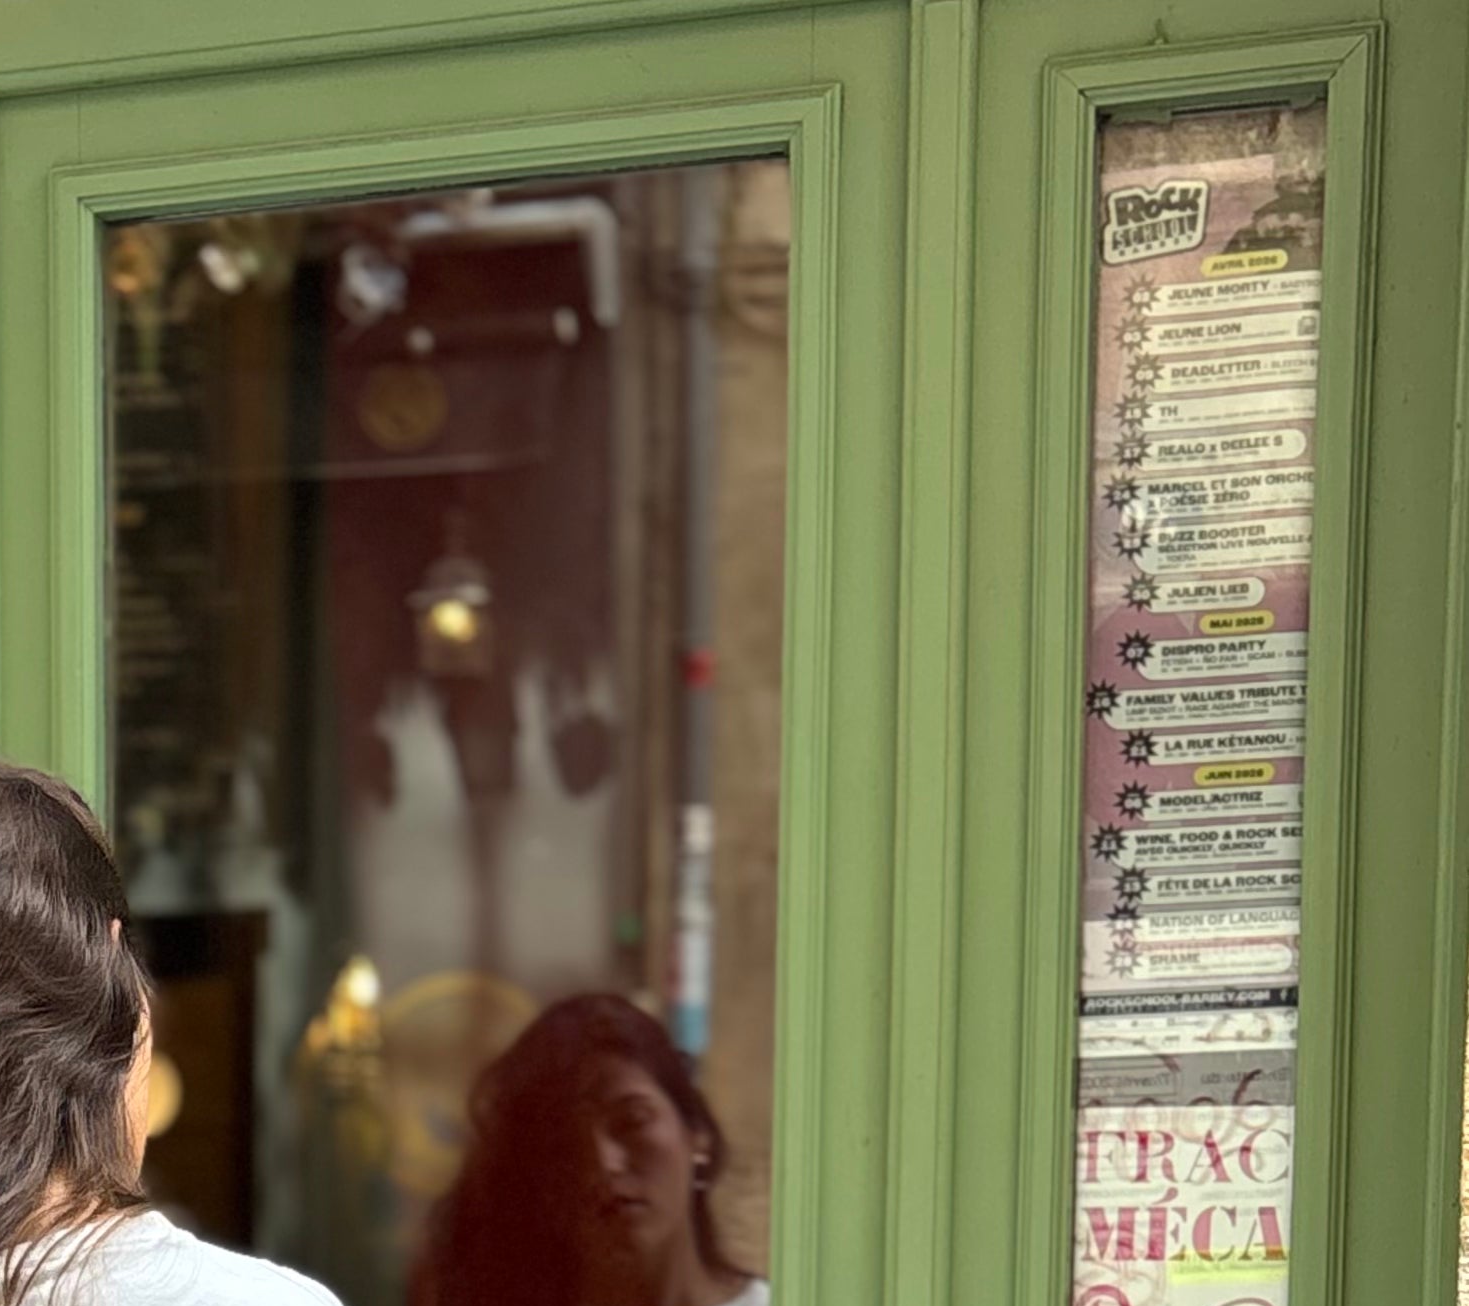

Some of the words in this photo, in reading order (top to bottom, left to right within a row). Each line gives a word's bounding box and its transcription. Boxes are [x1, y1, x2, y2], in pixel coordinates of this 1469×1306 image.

[1114, 187, 1202, 227] ROCK
[1112, 213, 1199, 250] SCHOOL
[1167, 286, 1214, 301] JEUNE
[1217, 280, 1270, 295] MORTY
[1158, 327, 1204, 341] JEUNE
[1207, 323, 1242, 336] LION
[1171, 360, 1261, 378] DEADLETTER
[1159, 406, 1178, 416] TH
[1157, 443, 1205, 456] REALO
[1148, 481, 1207, 495] MARCEL
[1210, 479, 1227, 490] ET
[1231, 476, 1261, 489] SON
[1158, 531, 1195, 544] BUZZ
[1198, 525, 1266, 540] BOOSTER
[1167, 585, 1217, 598] JULIEN
[1220, 583, 1249, 595] LIEB
[1210, 619, 1233, 629] MAI
[1219, 640, 1266, 653] PARTY
[1126, 693, 1176, 706] FAMILY
[1180, 689, 1235, 703] VALUES
[1239, 685, 1296, 699] TRIBUTE
[1164, 740, 1182, 751] LA
[1187, 738, 1213, 749] RUE
[1217, 733, 1286, 748] KÉTANOU
[1180, 831, 1218, 843] FOOD
[1236, 827, 1276, 839] ROCK
[1193, 878, 1210, 888] DE
[1214, 877, 1230, 887] LA
[1236, 875, 1277, 886] ROCK
[1149, 914, 1205, 928] NATION
[1208, 913, 1225, 925] OF
[1149, 953, 1200, 966] SHAME
[1083, 1129, 1291, 1185] FRAC
[1081, 1187, 1287, 1262] MÉCA
